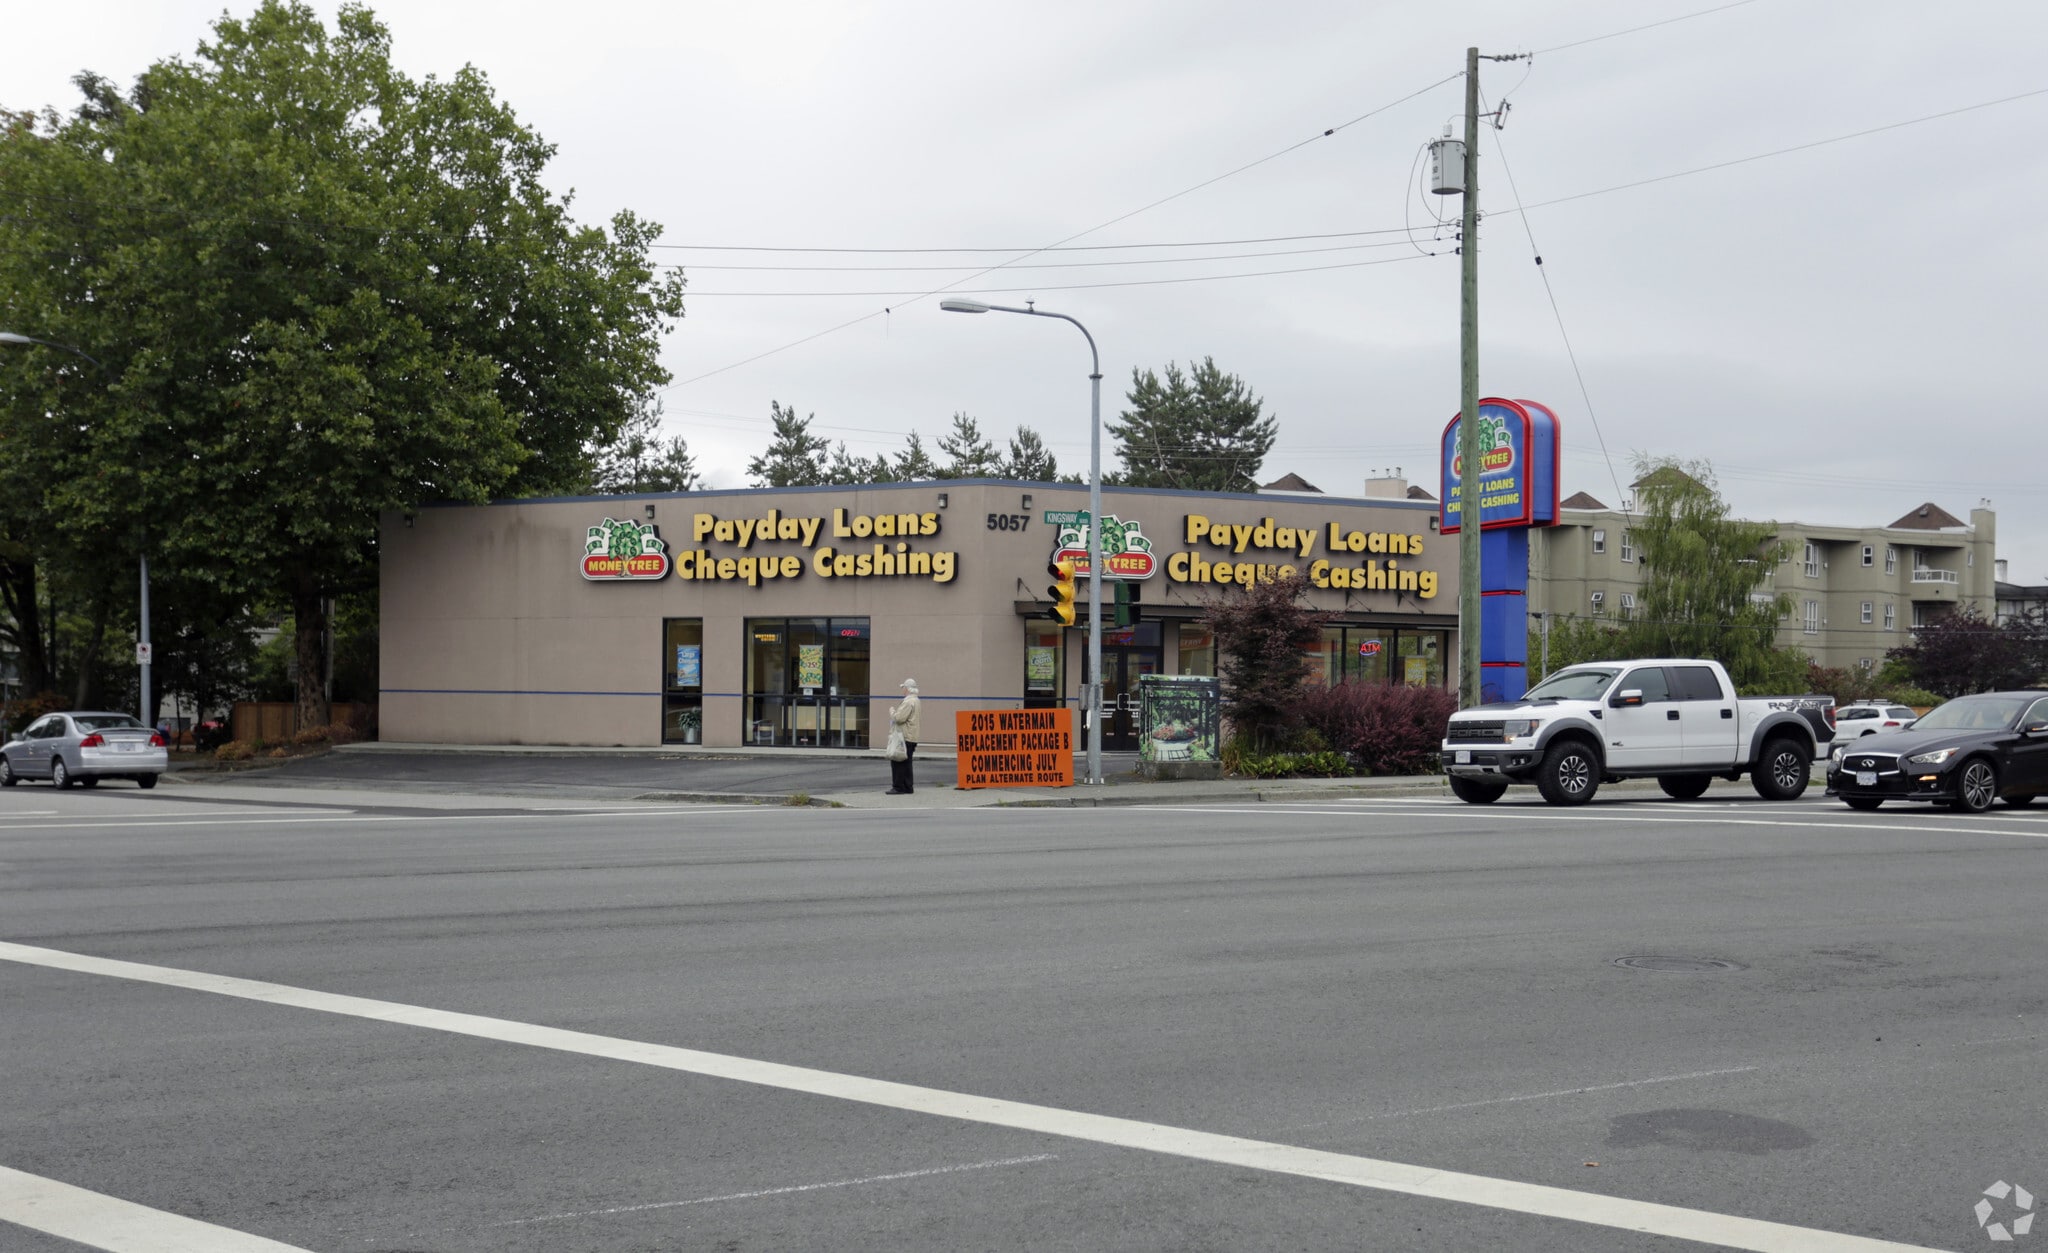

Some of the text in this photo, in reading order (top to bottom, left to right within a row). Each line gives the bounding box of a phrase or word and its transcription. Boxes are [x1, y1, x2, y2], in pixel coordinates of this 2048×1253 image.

[1456, 452, 1508, 471] MYTREE
[1486, 478, 1515, 492] LOANS
[1481, 493, 1519, 508] CASHING
[694, 508, 938, 548] Payday Loans
[987, 513, 1031, 532] 5057
[1047, 513, 1078, 524] KINGSWAY
[1187, 514, 1424, 557] Payday Loans
[588, 559, 660, 572] MONEYTREE
[676, 542, 955, 586] Cheque Cashing
[1168, 552, 1437, 599] Cheque Cashing
[841, 629, 861, 637] OPEN
[1360, 642, 1381, 652] ATM
[1768, 702, 1821, 711] RAPTOR
[971, 712, 1055, 731] 2015 WATERMAIN
[959, 732, 1069, 752] REPLACEMENT PACKAGE B
[971, 753, 1057, 772] COMMENCING JULY
[966, 772, 1064, 784] PLAN ALTERNATE ROUTE
